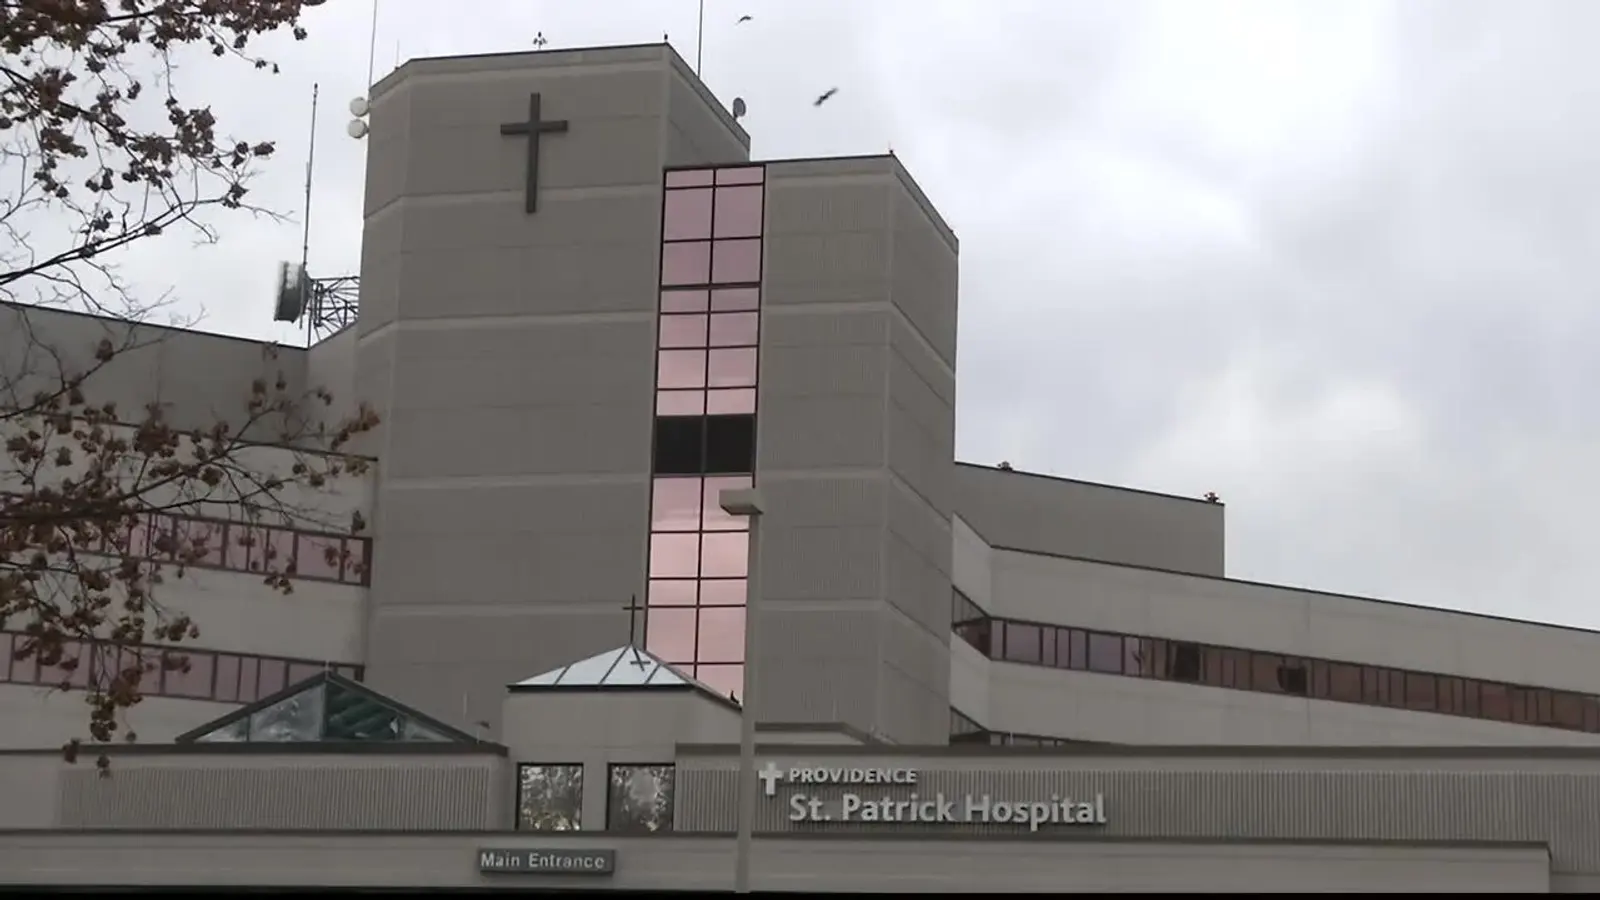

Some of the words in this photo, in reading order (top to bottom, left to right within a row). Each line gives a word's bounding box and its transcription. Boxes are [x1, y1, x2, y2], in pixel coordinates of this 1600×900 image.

[789, 768, 917, 784] PROVIDENCE
[789, 793, 831, 822] St.
[842, 793, 956, 823] Patrick
[965, 794, 1106, 832] Hospital
[481, 850, 520, 867] Main
[528, 852, 605, 869] Entrance
